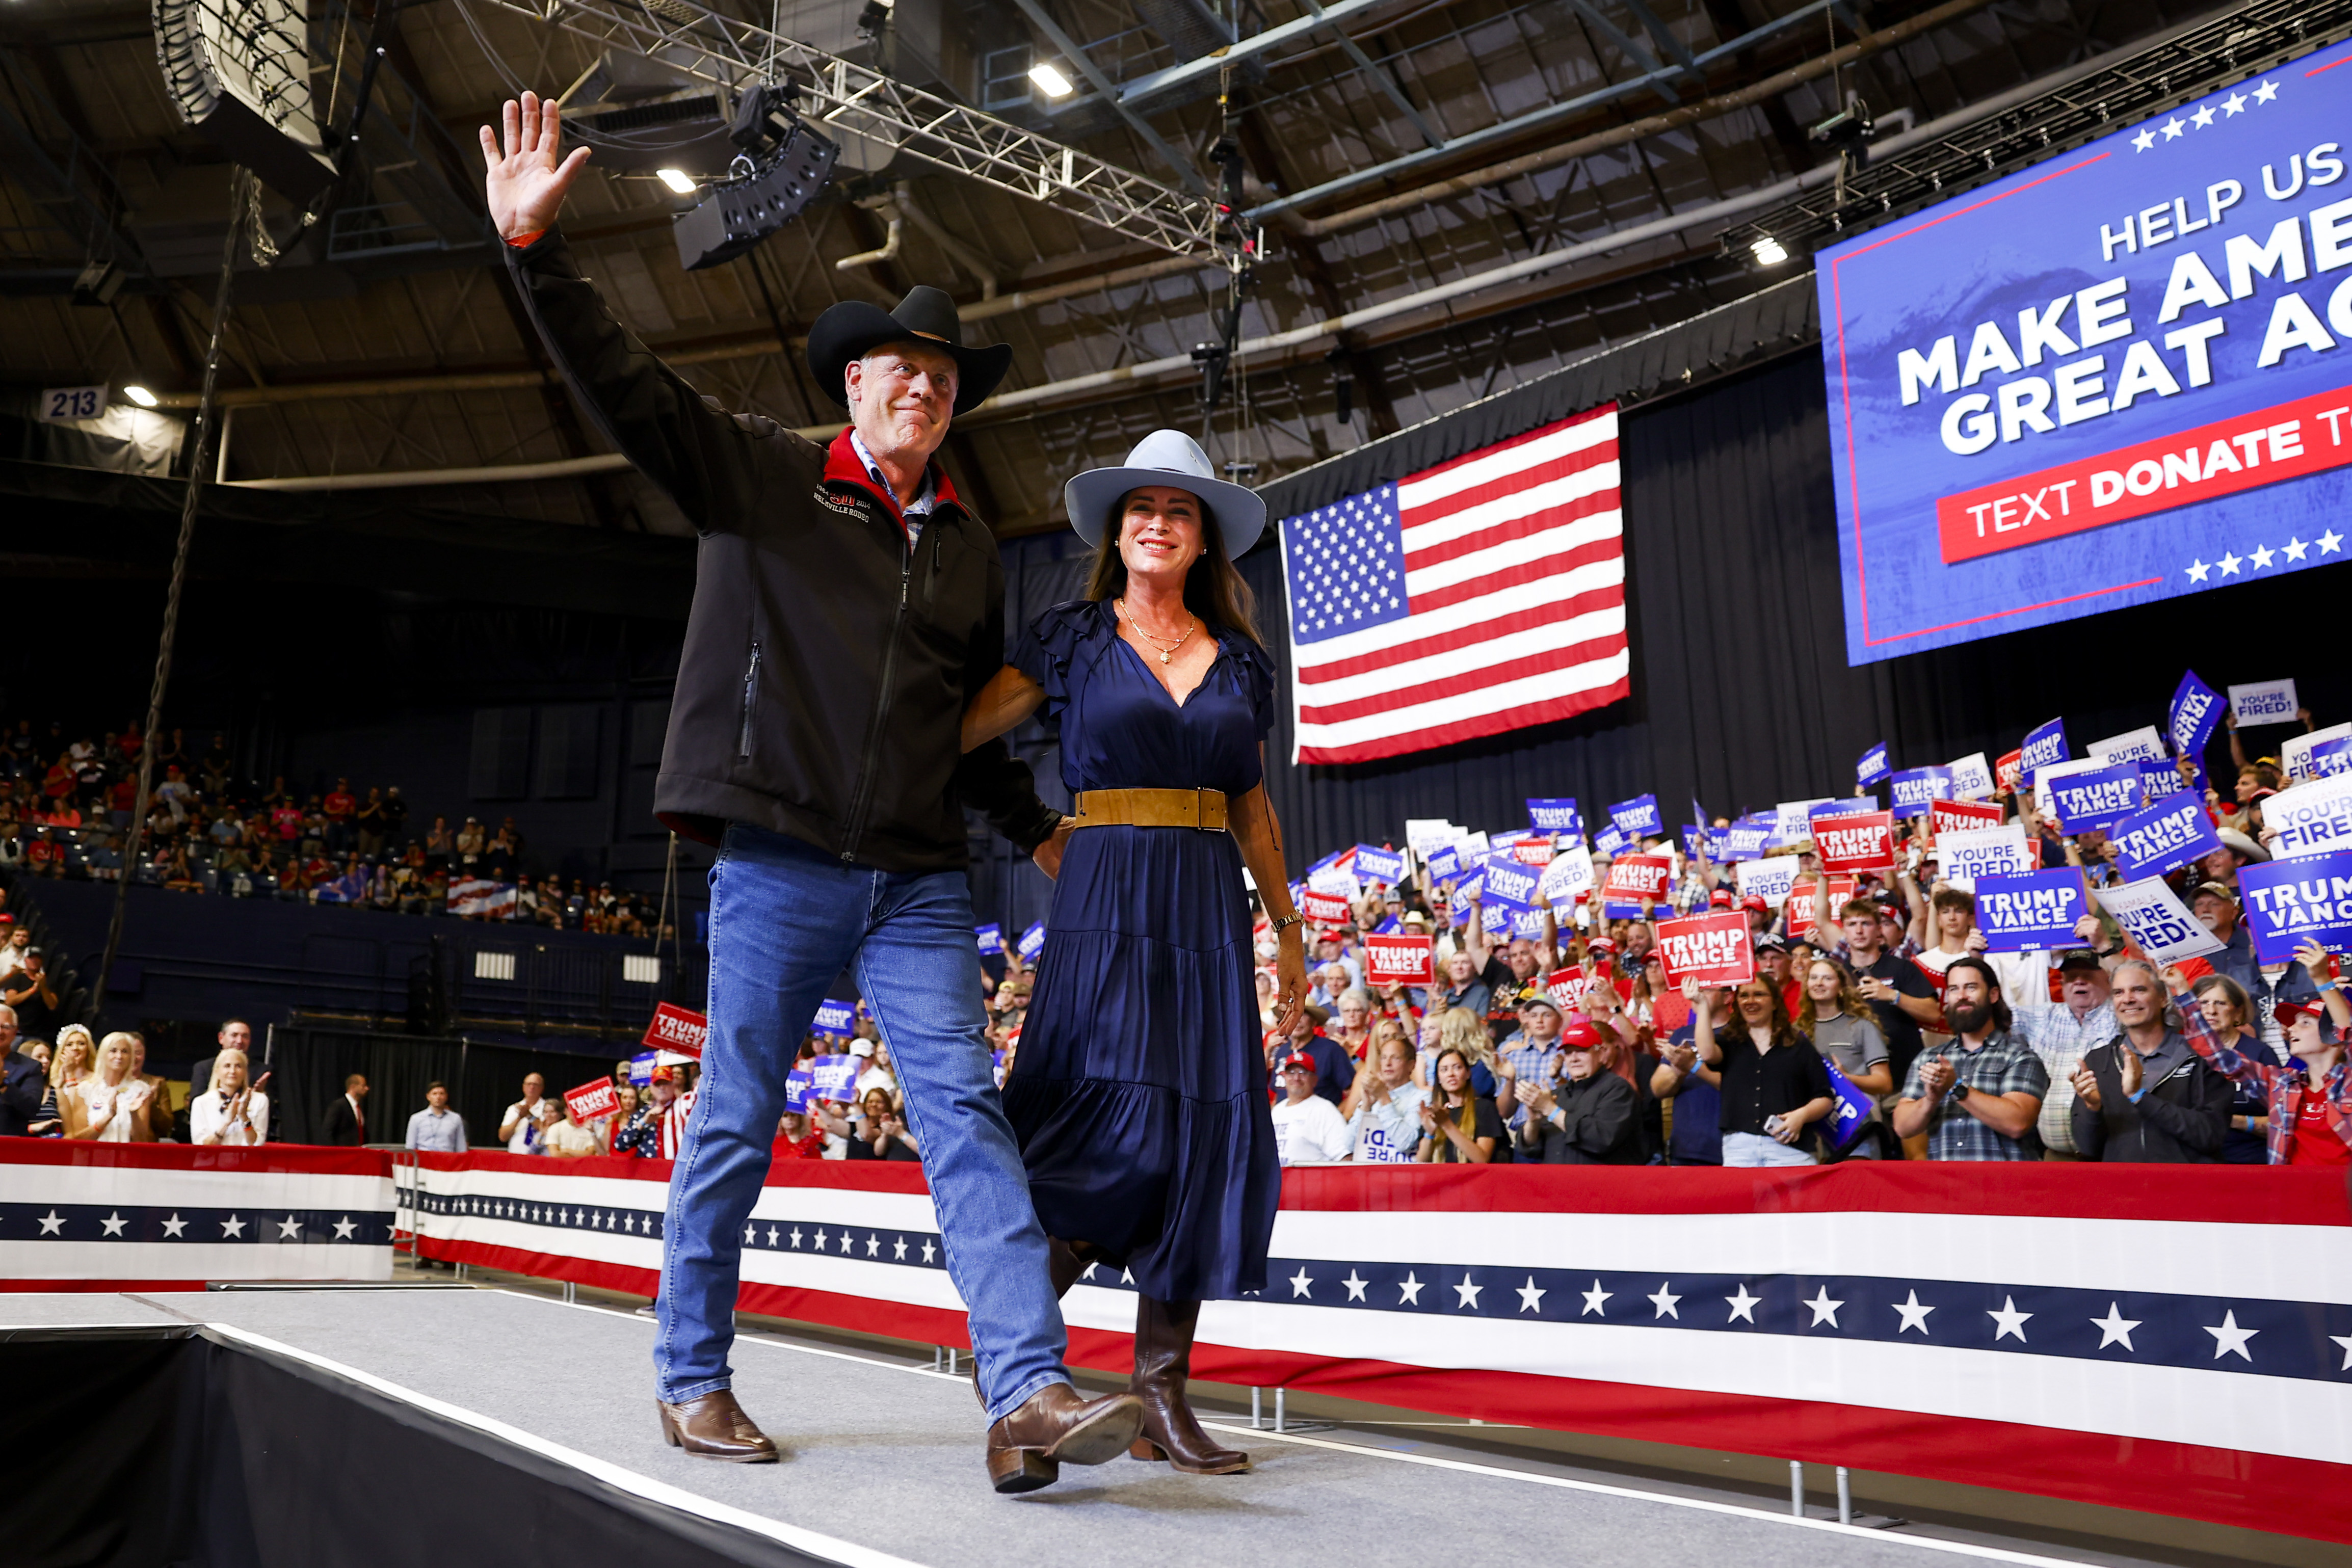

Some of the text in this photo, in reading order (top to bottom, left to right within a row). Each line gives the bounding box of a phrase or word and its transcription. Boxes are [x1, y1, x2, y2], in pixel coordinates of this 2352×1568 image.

[2100, 142, 2344, 260] HELP US
[1897, 276, 2133, 406] MAKE
[1940, 316, 2225, 456] GREAT
[51, 391, 96, 416] 213
[1966, 406, 2352, 537] TEXT DONATE T
[856, 500, 870, 509] 2014
[849, 508, 869, 523] RODEO
[2238, 701, 2292, 716] FIRED!
[2240, 692, 2286, 705] YOU'RE
[2108, 743, 2151, 763] OU'RE
[1893, 777, 1950, 795] TRUMP
[2056, 778, 2137, 805] TRUMP
[1529, 807, 1575, 820] TRUMP
[2068, 793, 2131, 815] VANCE
[1612, 804, 1655, 825] TRUMP
[1935, 810, 1998, 829] TRUMP
[1730, 829, 1769, 841] TRUMP
[1816, 825, 1888, 847] TRUMP
[2112, 805, 2199, 854] TRUMP
[1826, 840, 1882, 857] VANCE
[2128, 823, 2198, 861] VANCE
[1952, 844, 2015, 862] YOU'RE
[1488, 865, 1536, 889] TRUMP
[1611, 864, 1667, 880] TRUMP
[1748, 871, 1790, 884] YOU'RE
[1949, 858, 2021, 880] FIRED!
[1613, 875, 1659, 889] VANCE
[1305, 897, 1347, 911] TRUMP
[1979, 887, 2077, 913] TRUMP
[1990, 907, 2068, 927] VANCE
[1660, 928, 1745, 955] TRUMP
[1368, 946, 1430, 961] TRUMP
[1669, 947, 1736, 968] VANCE
[1375, 960, 1422, 971] VANCE
[569, 1086, 612, 1109] TRUMP
[574, 1095, 610, 1114] VANCE
